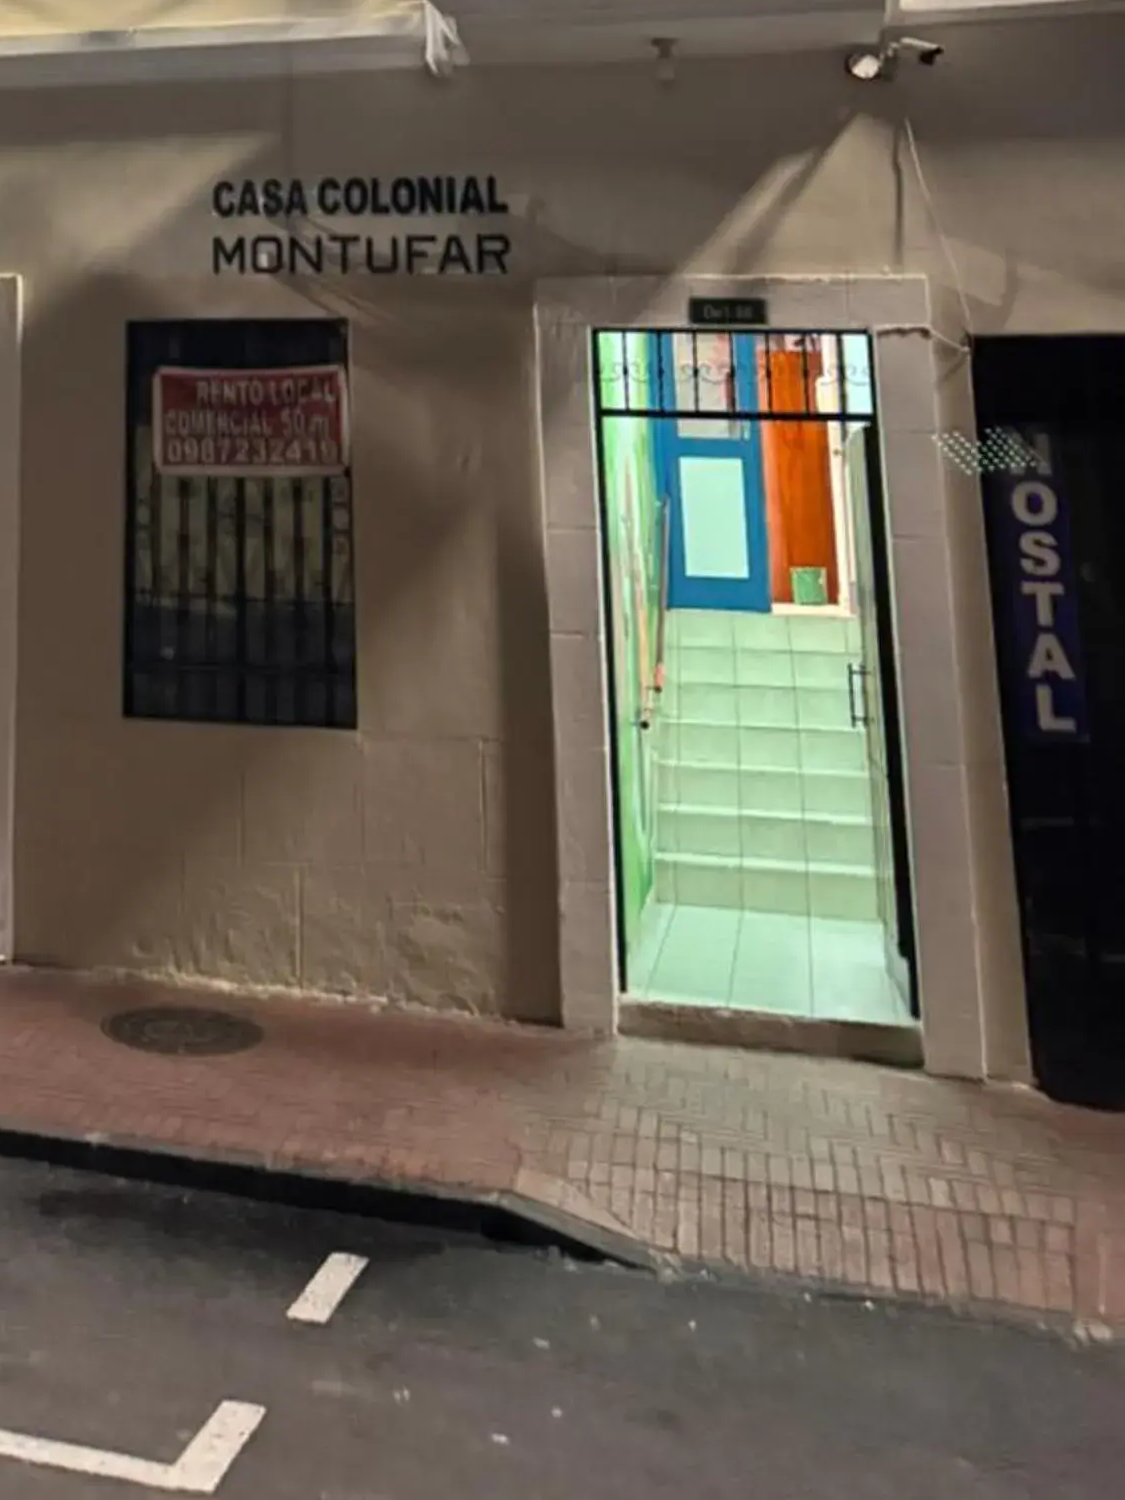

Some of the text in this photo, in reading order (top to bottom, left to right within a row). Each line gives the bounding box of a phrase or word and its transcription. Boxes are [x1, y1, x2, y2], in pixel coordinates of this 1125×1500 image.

[211, 174, 509, 218] CASA COLONIAL
[211, 233, 512, 275] MONTUFAR
[195, 376, 337, 407] RENTO LOCAL
[164, 408, 273, 437] COMERCIAL
